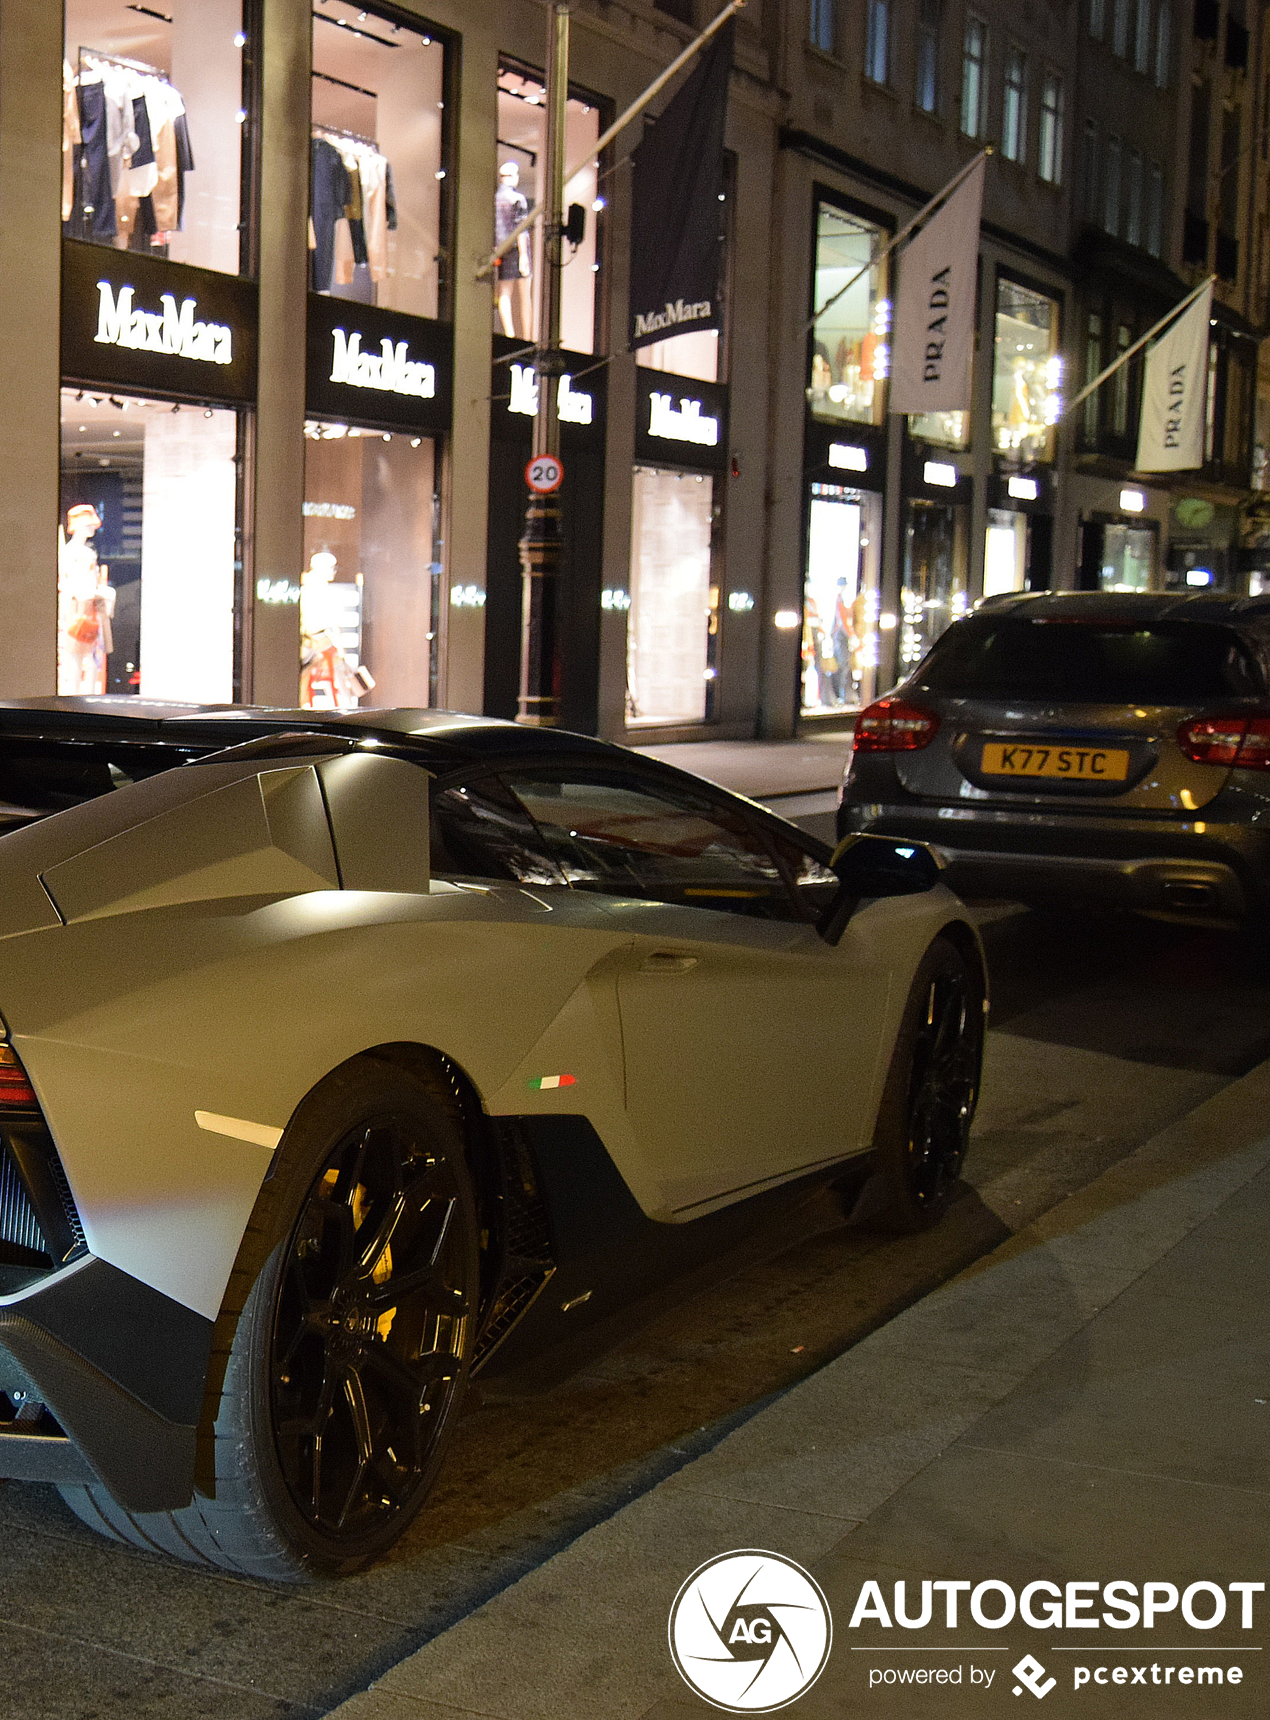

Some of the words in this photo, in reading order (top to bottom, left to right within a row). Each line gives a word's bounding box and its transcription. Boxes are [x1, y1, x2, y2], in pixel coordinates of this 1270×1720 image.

[94, 280, 232, 364] MaxMara
[922, 265, 952, 383] PRADA
[330, 327, 436, 398] MaxMara
[1164, 363, 1187, 449] PRADA
[532, 466, 558, 482] 20
[1001, 747, 1050, 771] K77
[1057, 751, 1107, 774] STC
